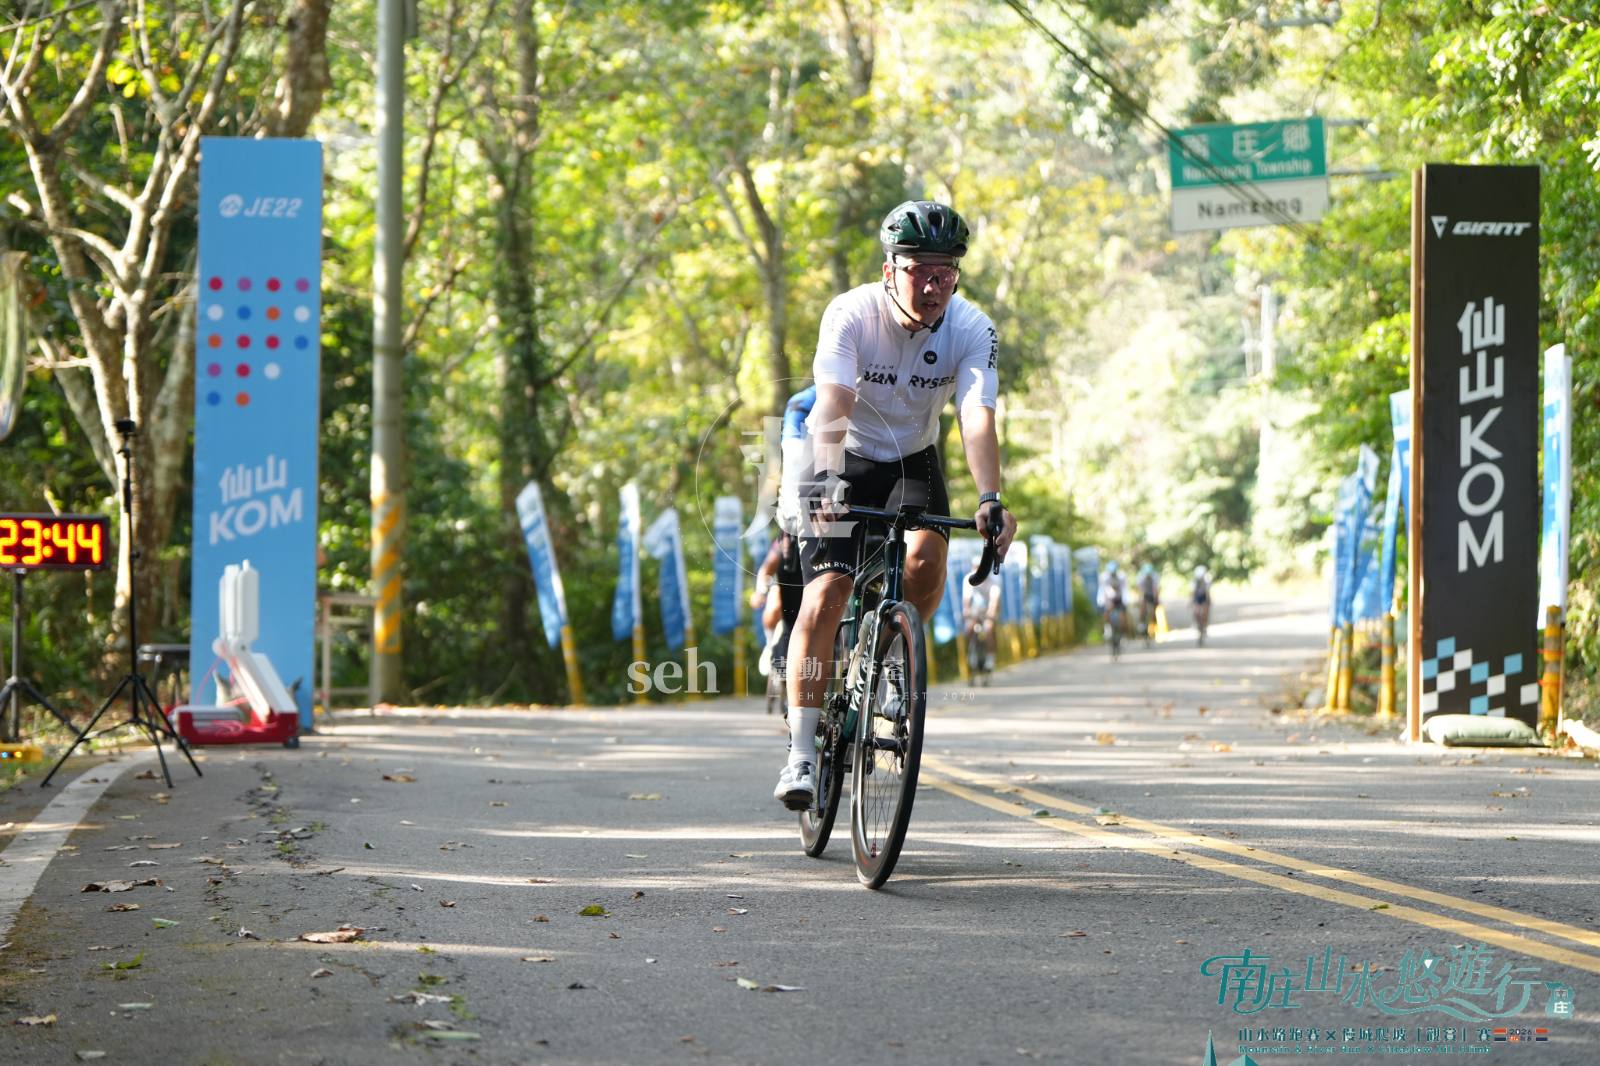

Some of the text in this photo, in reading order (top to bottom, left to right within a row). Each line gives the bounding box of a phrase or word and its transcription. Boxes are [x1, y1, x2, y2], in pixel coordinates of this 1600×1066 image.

[243, 197, 303, 218] JE22
[1452, 221, 1532, 236] GIANT
[863, 370, 898, 386] VAN
[1456, 296, 1505, 573] 仙山 KOM
[219, 454, 288, 503] 仙山
[208, 488, 303, 546] KOM
